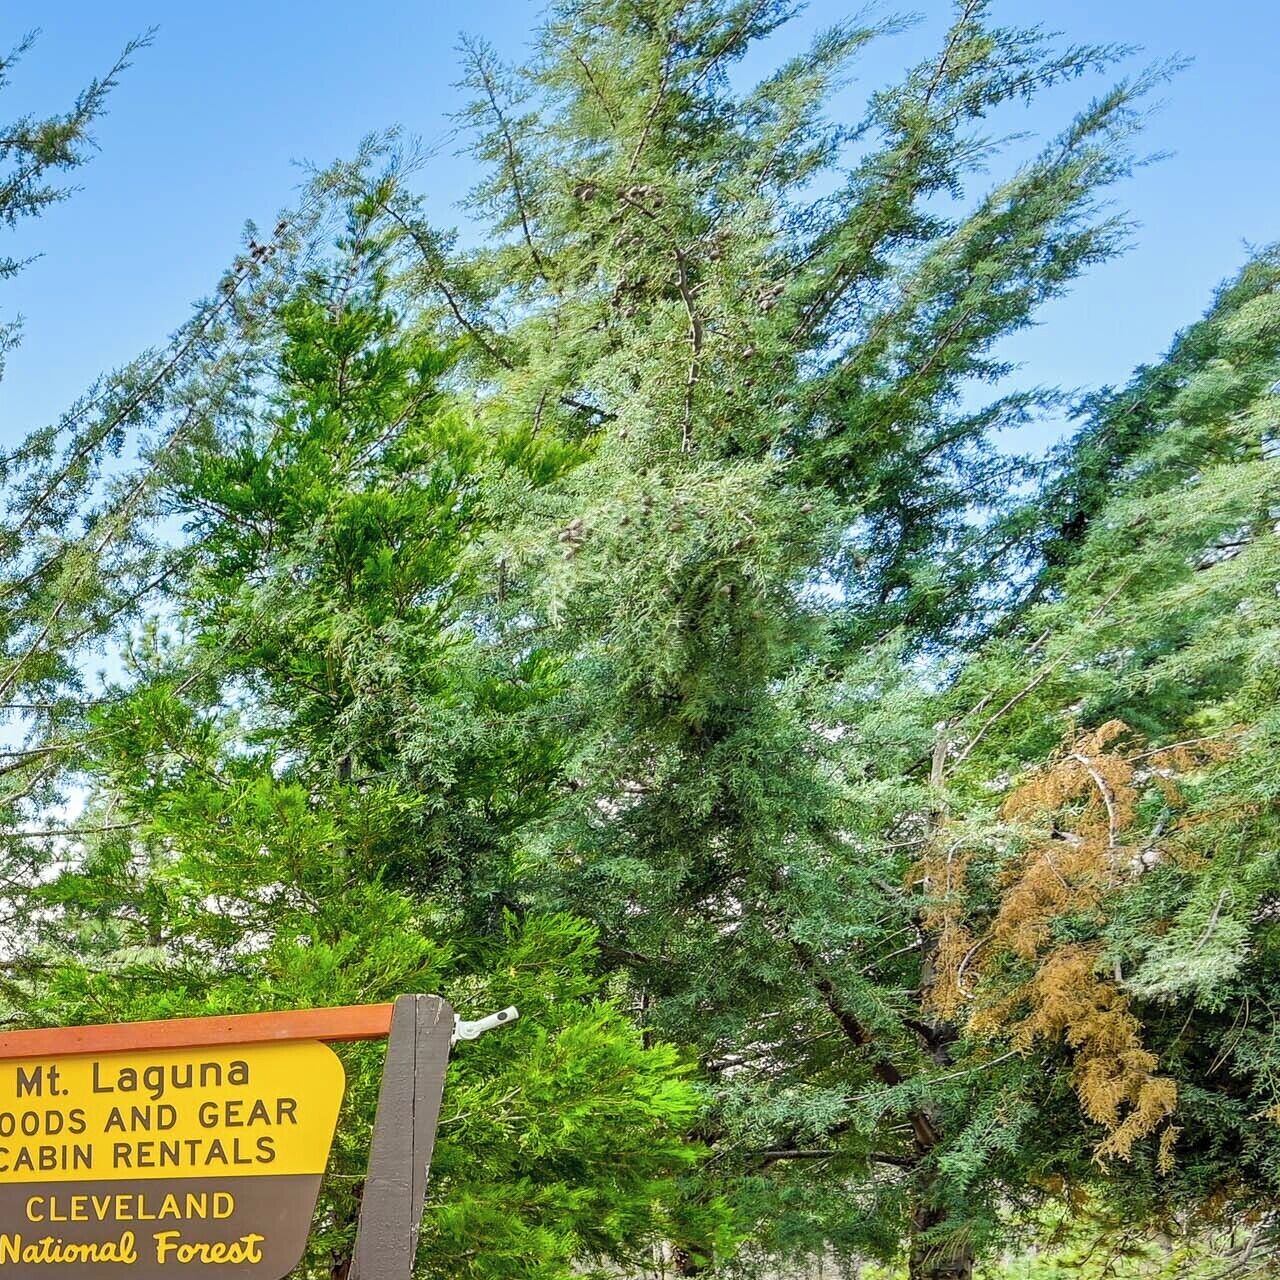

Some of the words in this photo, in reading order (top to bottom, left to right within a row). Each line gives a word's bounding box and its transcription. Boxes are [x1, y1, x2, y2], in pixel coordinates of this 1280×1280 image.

[16, 1065, 69, 1098] Mt.
[92, 1060, 249, 1100] Laguna
[103, 1104, 177, 1133] AND
[198, 1097, 297, 1128] GEAR
[112, 1136, 276, 1169] RENTALS
[25, 1192, 235, 1222] CLEVELAND
[152, 1230, 265, 1264] Forest
